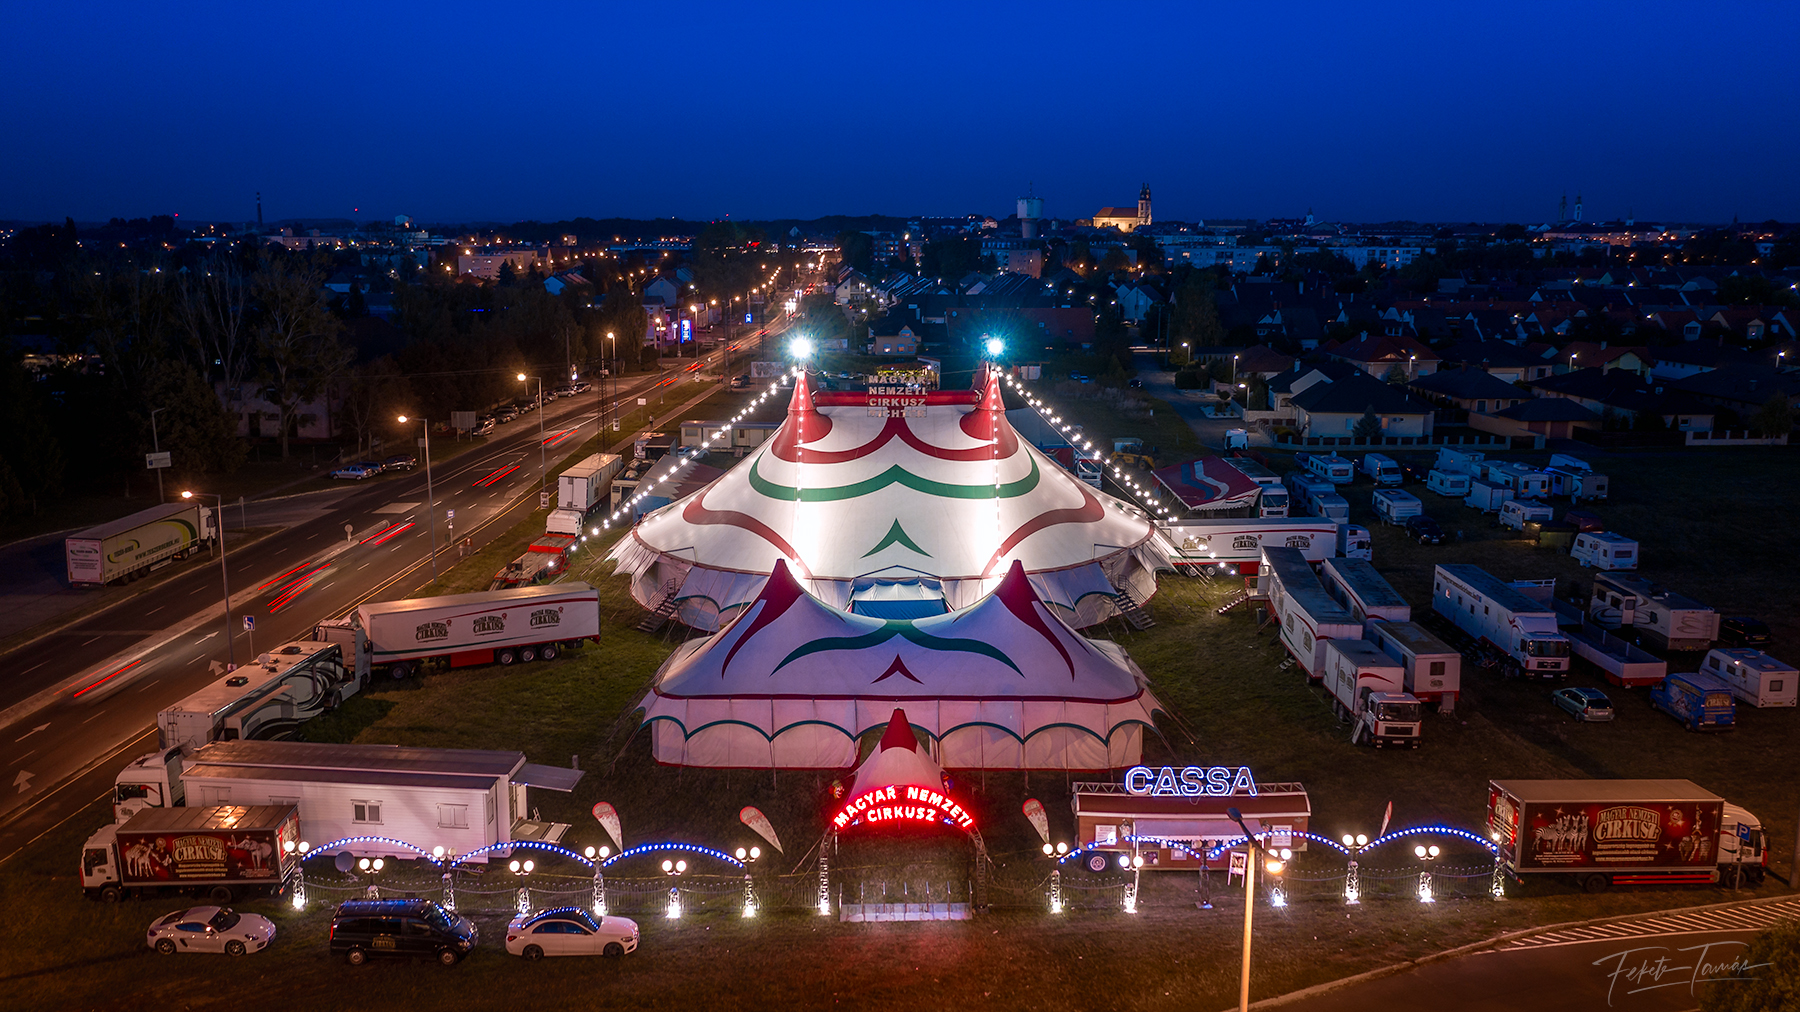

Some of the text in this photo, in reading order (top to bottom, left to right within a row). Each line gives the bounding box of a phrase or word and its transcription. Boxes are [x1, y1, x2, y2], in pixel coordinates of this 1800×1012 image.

[868, 375, 926, 384] MAGYAR
[868, 386, 927, 395] NEMZETI
[869, 398, 926, 407] CIRKUSZ
[530, 614, 561, 626] CIRKUSZ
[473, 621, 505, 633] CIRKUSZ
[415, 628, 449, 640] CIRKUSZ
[1124, 766, 1258, 797] CASSA
[834, 785, 973, 827] MAGYAR NEMZETI
[867, 806, 936, 822] CIRKUSZ
[1600, 808, 1658, 823] MAGYAR NEMZETI
[1596, 819, 1660, 840] CIRKUSZ
[1738, 825, 1749, 837] P
[174, 845, 226, 861] CIRKUSZ
